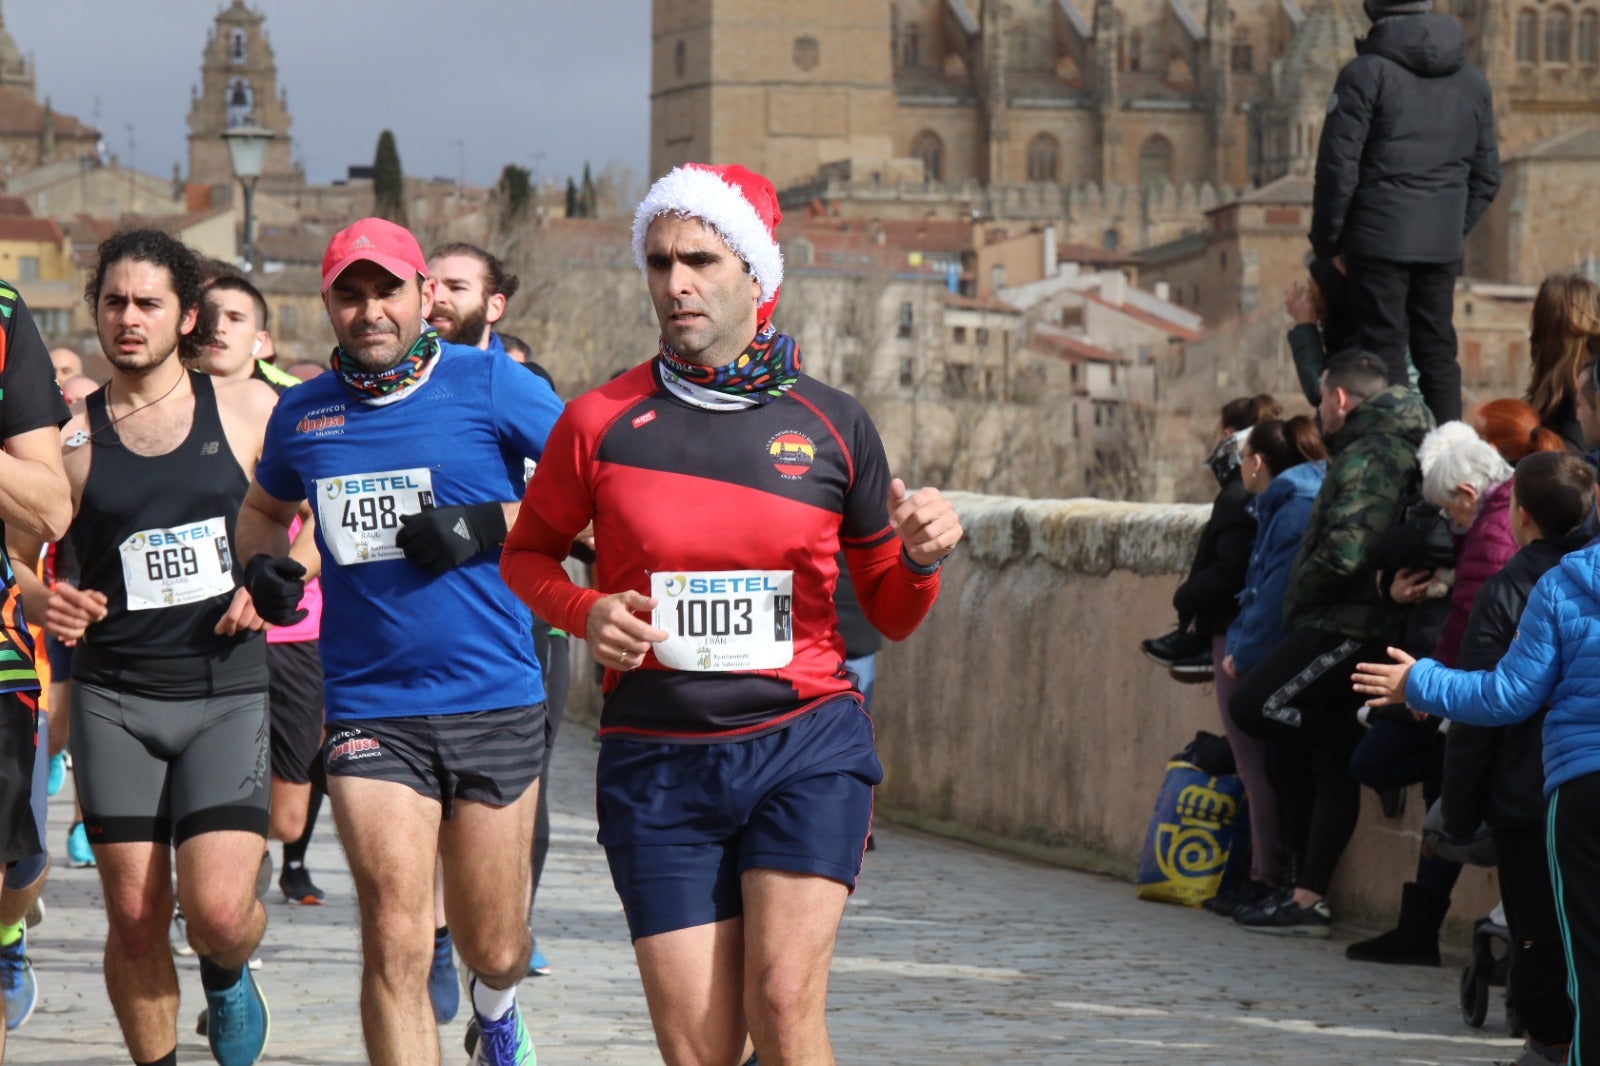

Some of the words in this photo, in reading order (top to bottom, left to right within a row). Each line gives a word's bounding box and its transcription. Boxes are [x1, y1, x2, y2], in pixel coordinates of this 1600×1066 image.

[345, 476, 418, 494] SETEL
[341, 495, 398, 532] 498
[148, 526, 216, 546] SETEL
[145, 547, 199, 581] 669
[689, 576, 778, 594] SETEL
[676, 598, 753, 637] 1003
